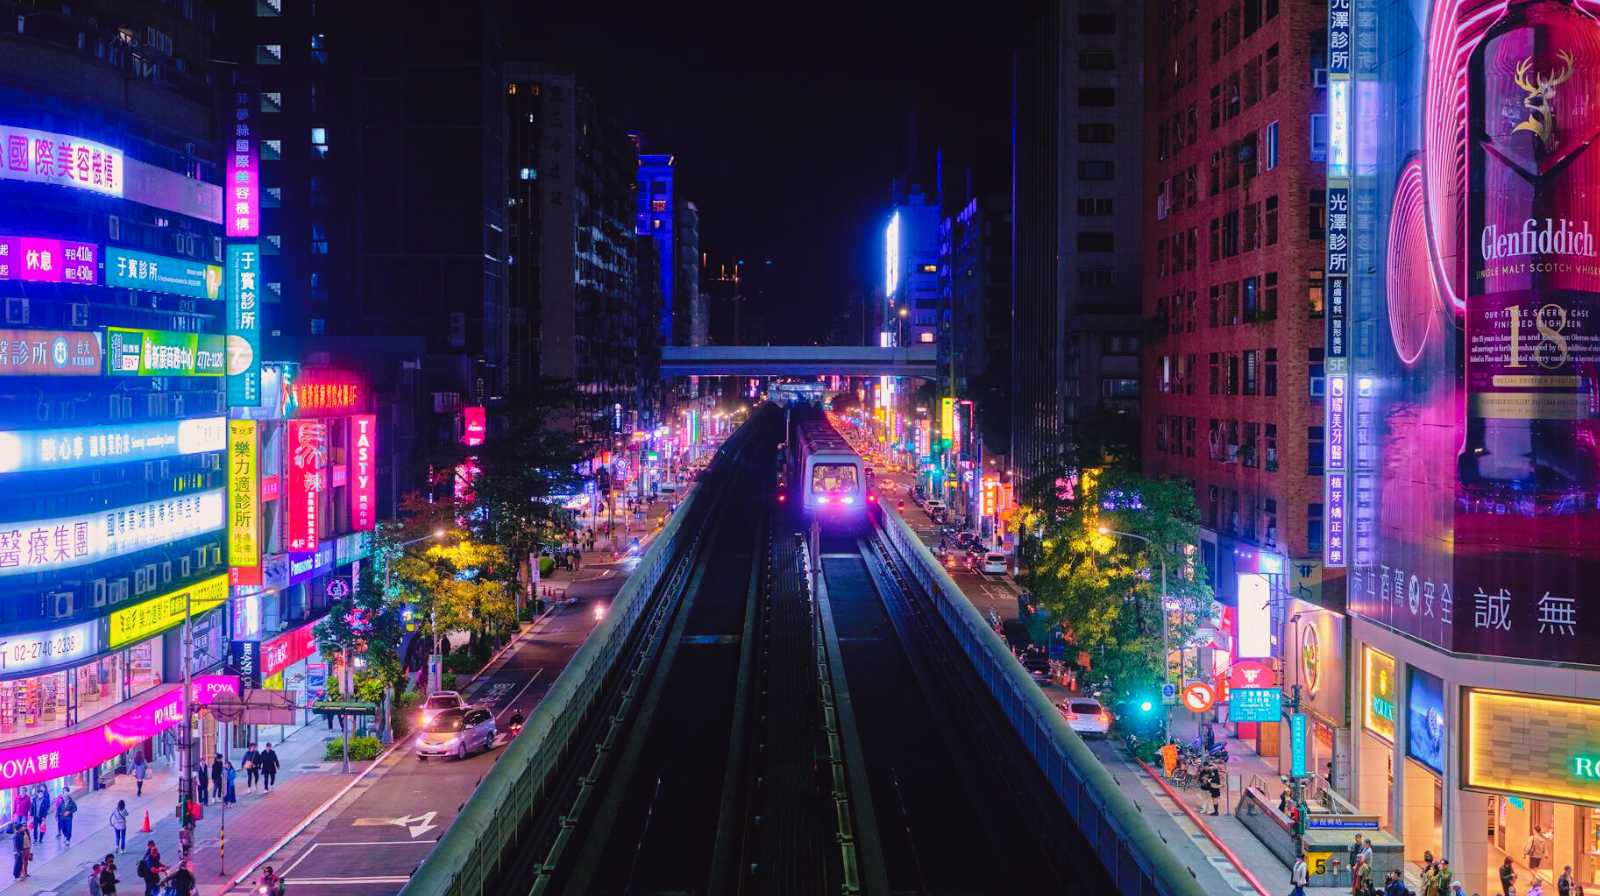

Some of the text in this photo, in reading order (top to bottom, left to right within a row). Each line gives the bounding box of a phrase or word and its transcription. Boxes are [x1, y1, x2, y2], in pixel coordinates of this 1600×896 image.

[1330, 194, 1347, 271] 光澤診所
[1481, 218, 1594, 261] Glenfiddich
[25, 249, 53, 276] 休息
[1502, 263, 1526, 275] MALT
[1529, 263, 1572, 273] SCOTCH
[240, 252, 256, 330] 于賓診所
[358, 420, 370, 488] TASTY
[234, 441, 251, 528] 樂力適診所
[207, 683, 234, 693] POYA
[38, 751, 60, 771] 寶雅
[1575, 756, 1600, 777] R
[1315, 859, 1326, 875] 5
